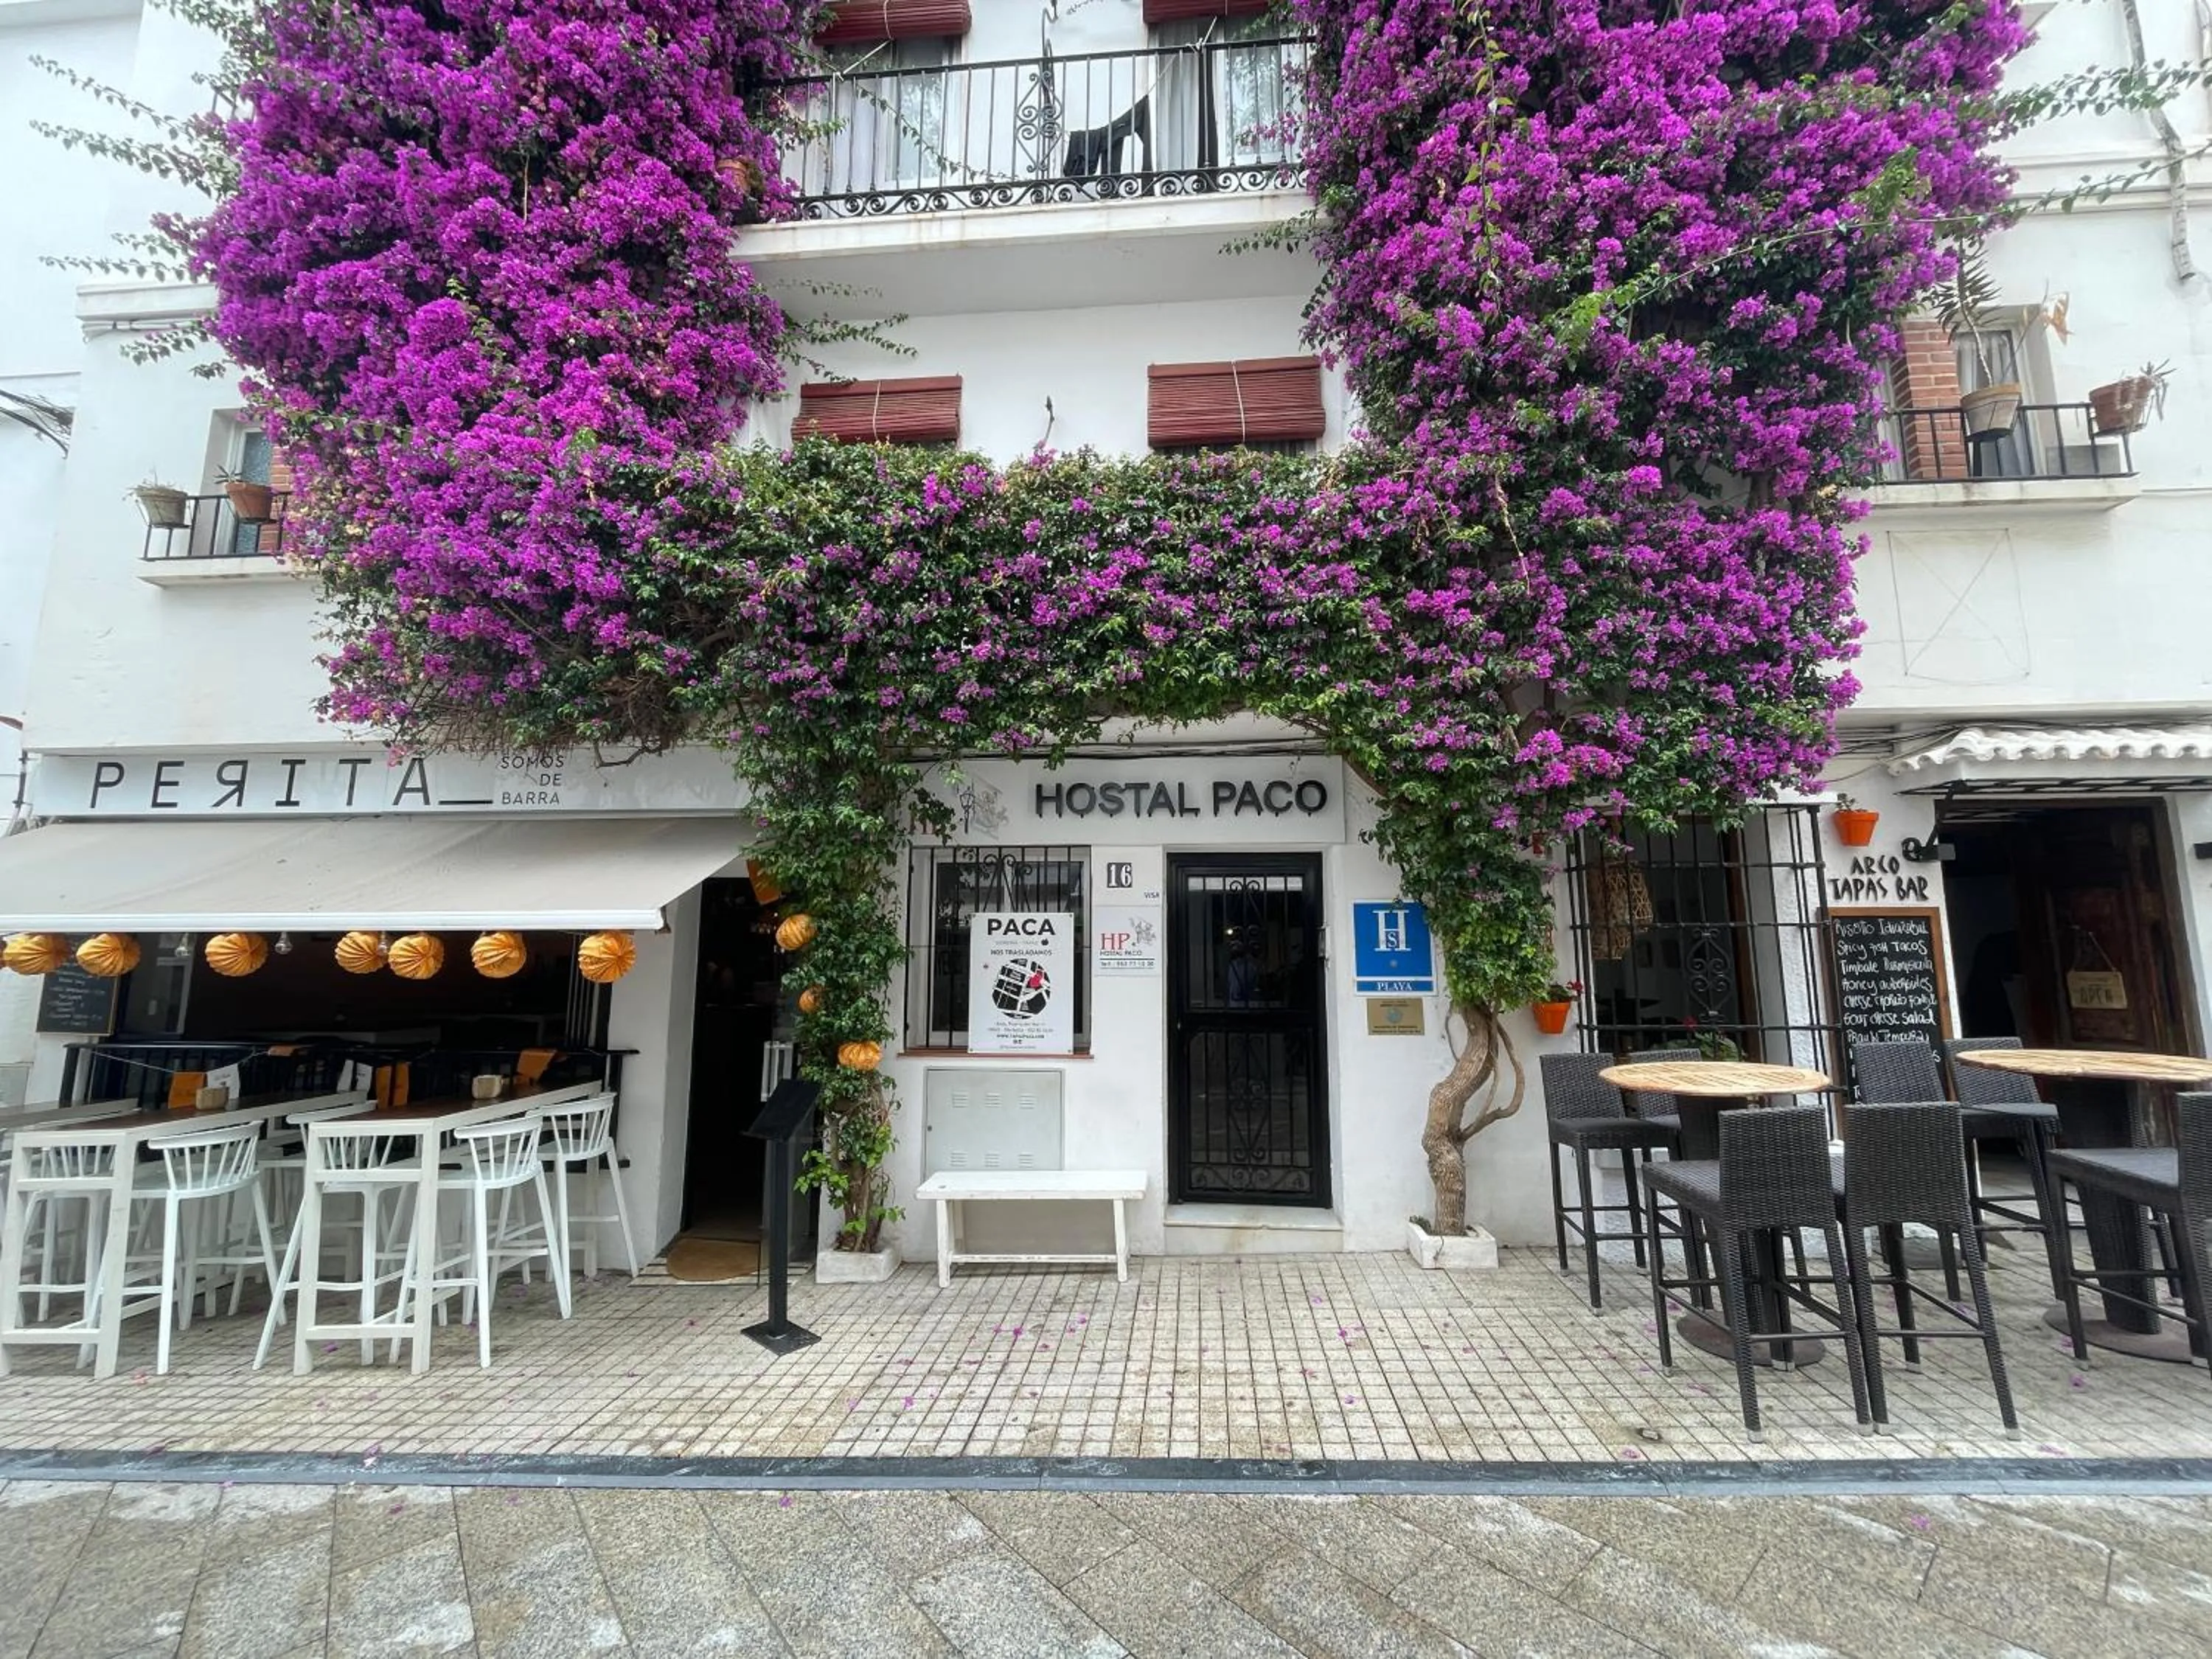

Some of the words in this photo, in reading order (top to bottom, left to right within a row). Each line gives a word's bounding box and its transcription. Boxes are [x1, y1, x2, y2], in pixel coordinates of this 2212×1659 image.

[501, 755, 564, 768] SOMOS
[539, 773, 563, 786] DE
[501, 791, 560, 804] BARRA
[1034, 782, 1201, 817] HOSTAL
[1212, 779, 1328, 816] PACO
[1851, 855, 1900, 875] ARCO
[1108, 863, 1132, 887] 16
[1829, 877, 1888, 901] TAPAS
[1896, 875, 1929, 901] BAR
[987, 918, 1056, 936] PACA
[1101, 933, 1130, 950] HP
[1837, 939, 1868, 959] Spicy
[1376, 981, 1413, 992] PLAYA
